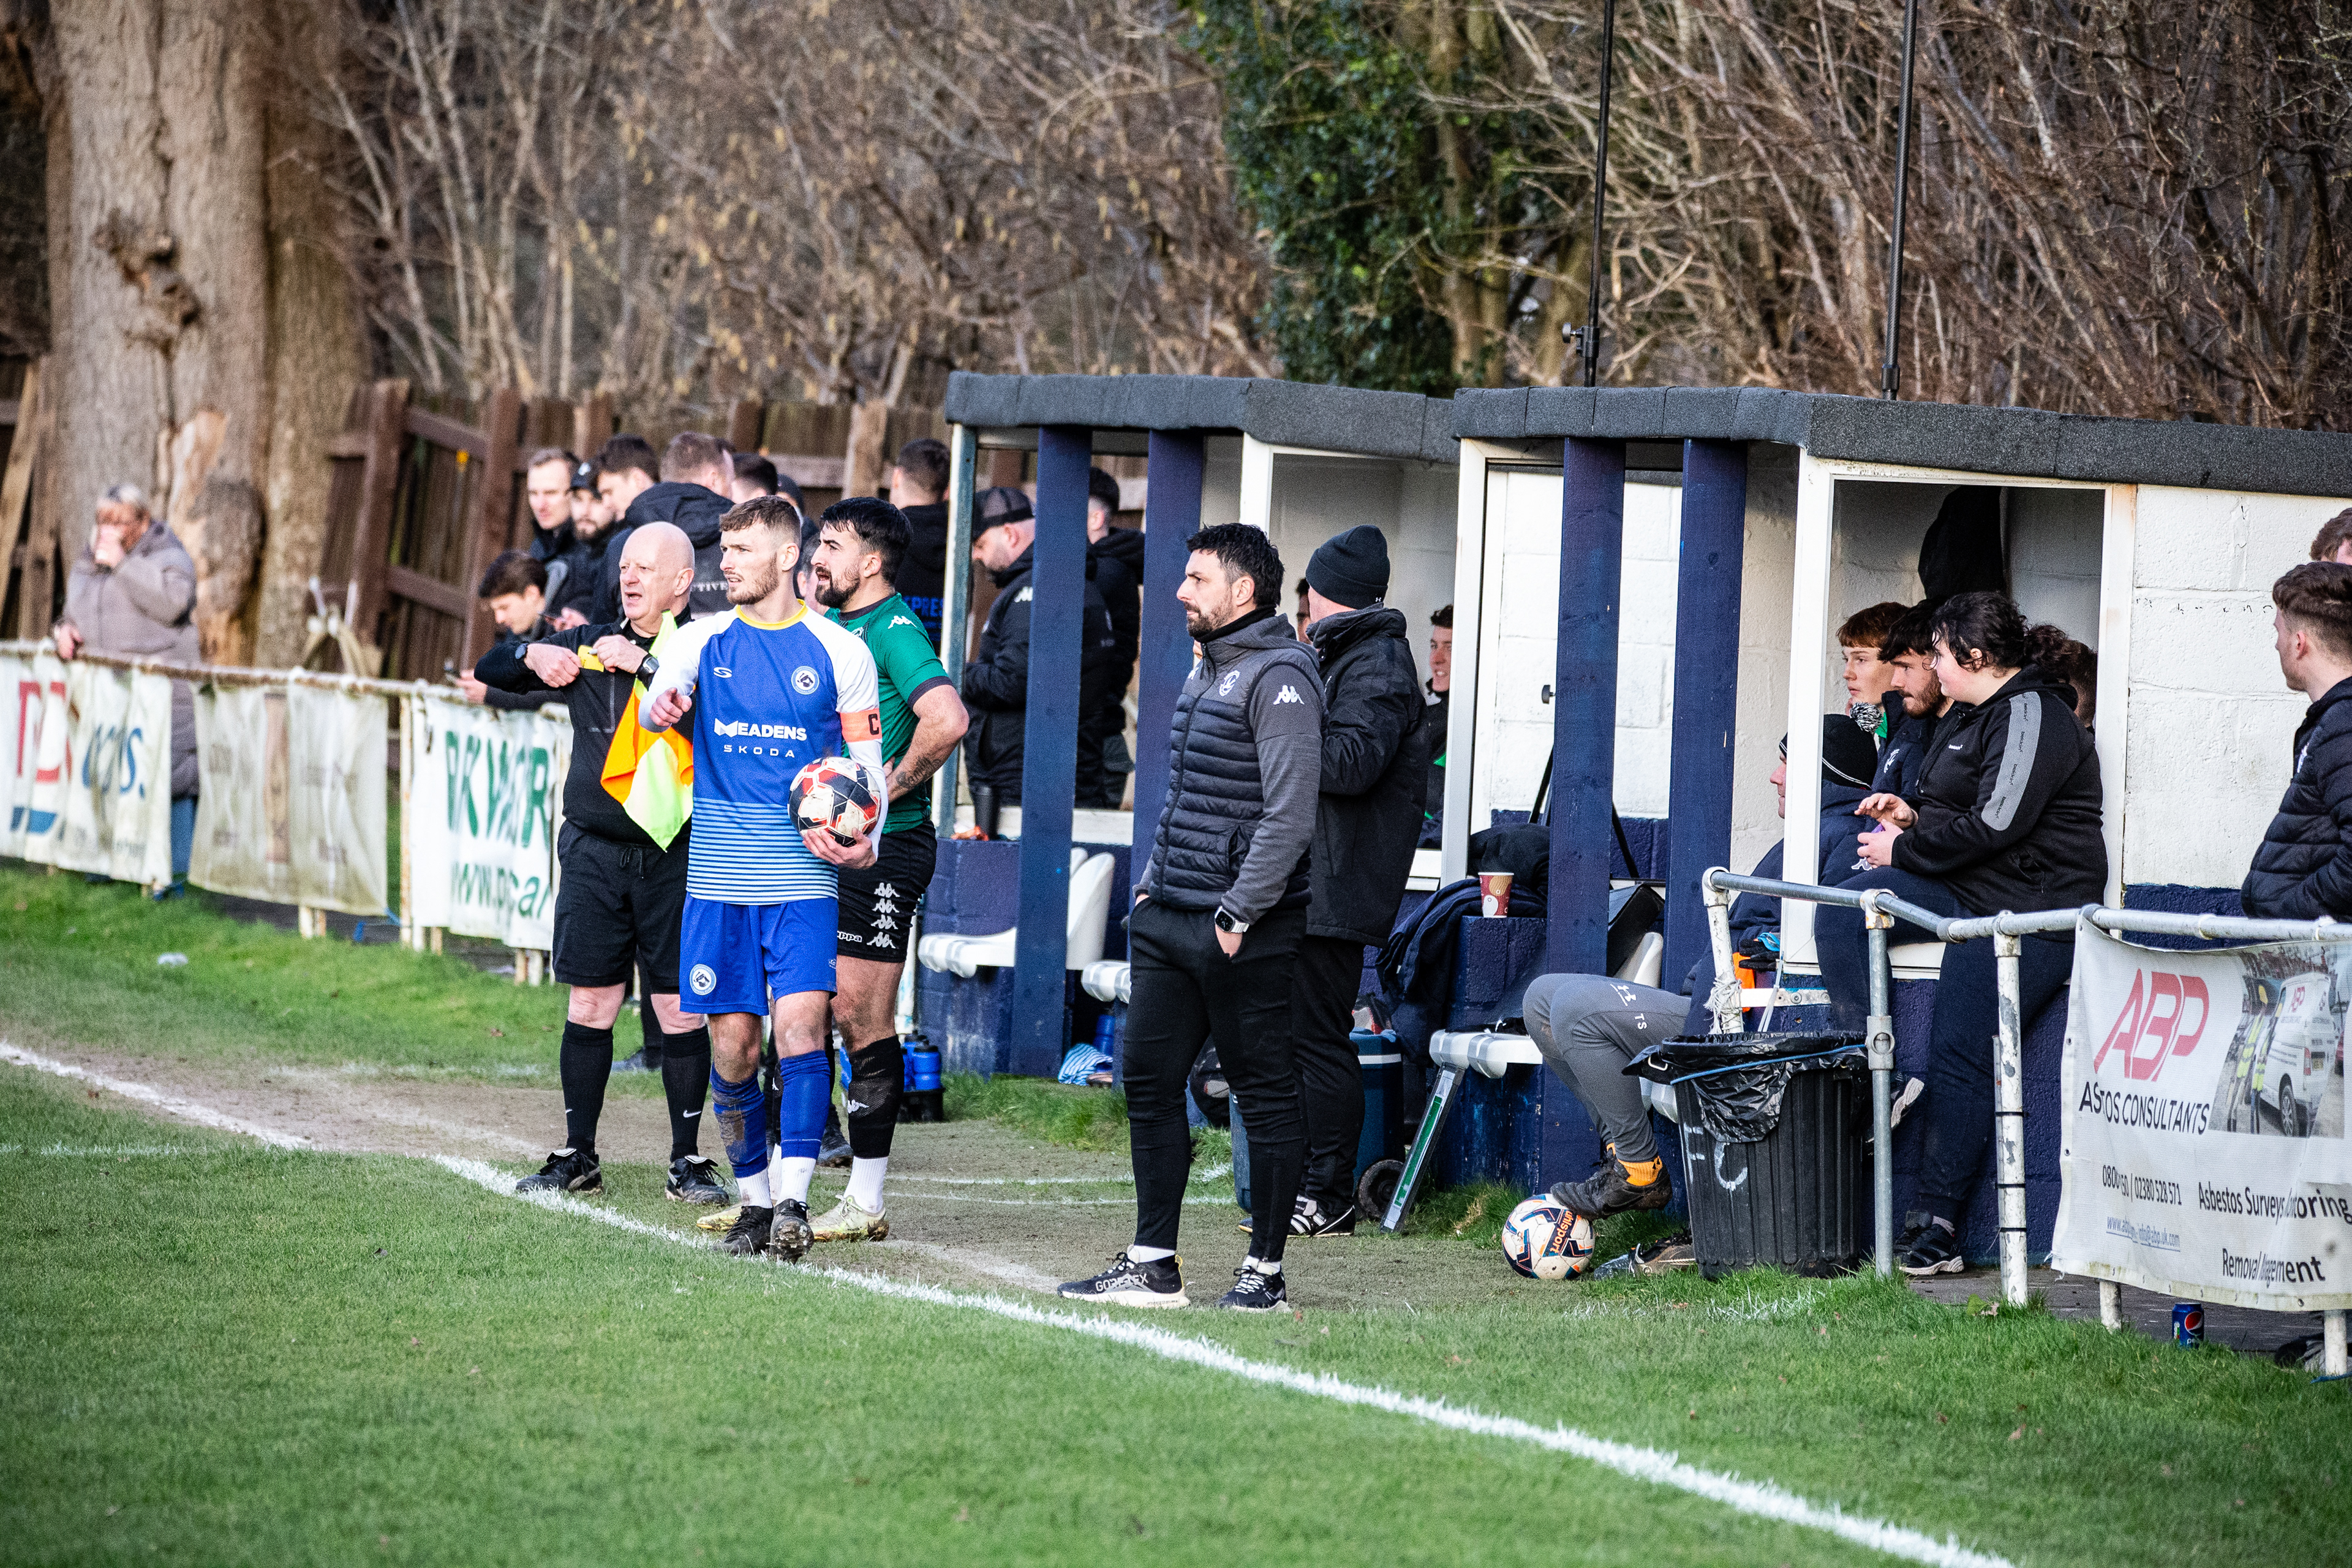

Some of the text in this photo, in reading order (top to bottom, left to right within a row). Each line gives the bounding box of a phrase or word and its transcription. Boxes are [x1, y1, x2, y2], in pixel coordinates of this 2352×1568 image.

[714, 718, 807, 741] MEADENS
[868, 714, 880, 735] C
[1634, 1013, 1648, 1030] TS
[2094, 968, 2209, 1082] ABP
[2122, 1093, 2210, 1136] CONSULTANTS
[2135, 1176, 2155, 1202] 02380
[2155, 1179, 2168, 1204] 528
[2168, 1182, 2182, 1206] 571
[2198, 1181, 2243, 1215] Asbestos
[2245, 1186, 2285, 1225] Surveys
[1550, 1210, 1574, 1254] uhlsport
[2222, 1248, 2262, 1281] Removal
